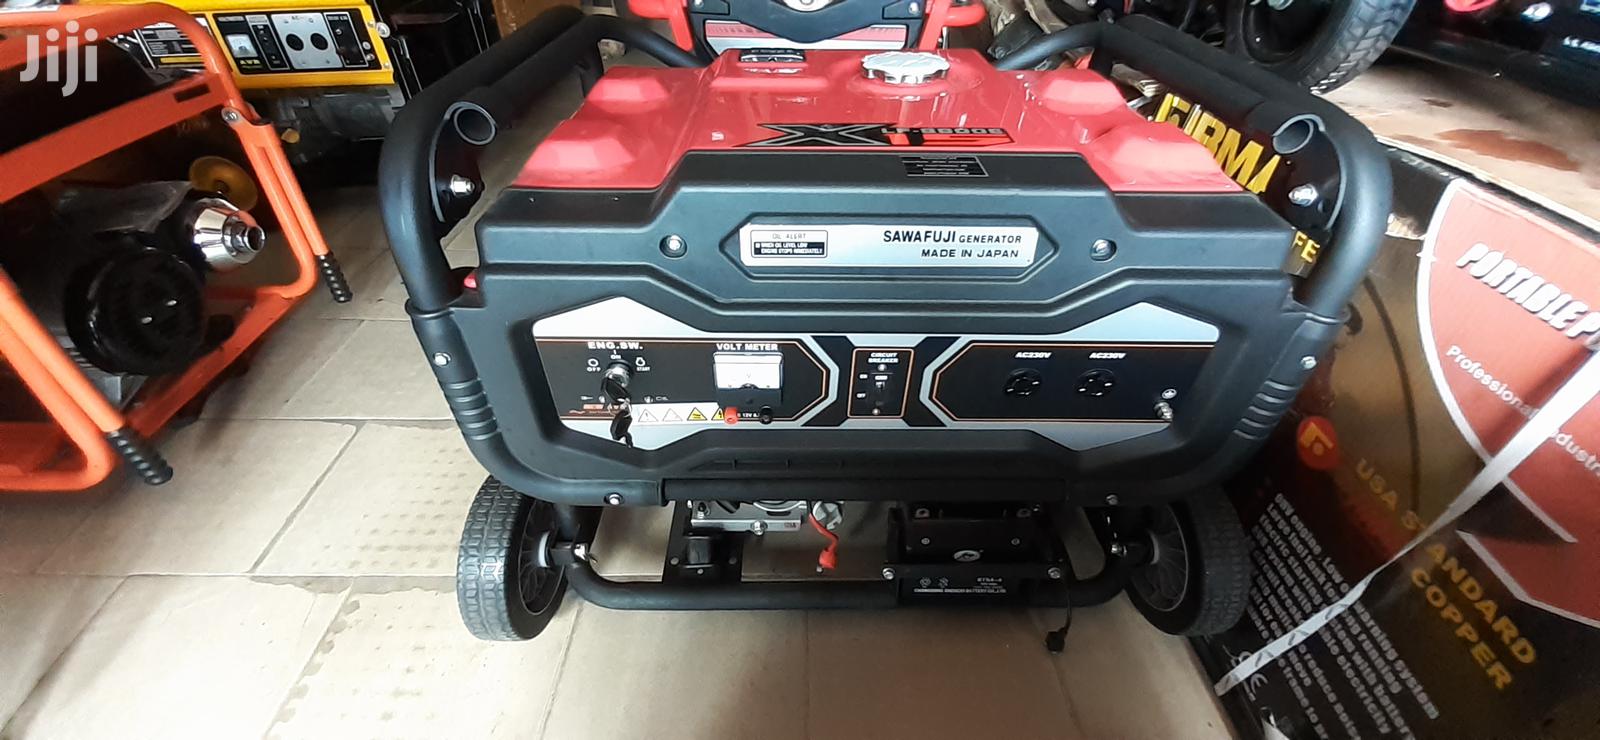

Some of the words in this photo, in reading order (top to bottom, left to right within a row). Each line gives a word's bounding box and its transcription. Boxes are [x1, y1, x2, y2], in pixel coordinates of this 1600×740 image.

[883, 230, 956, 242] SAWAFUJI
[960, 235, 1022, 243] GENERATOR
[921, 249, 956, 257] MADE
[977, 250, 1019, 258] JAPAN
[1455, 241, 1588, 331] PORTABLE
[588, 341, 644, 350] ENG.SW.
[1411, 567, 1512, 690] COPPER
[1392, 658, 1441, 720] system
